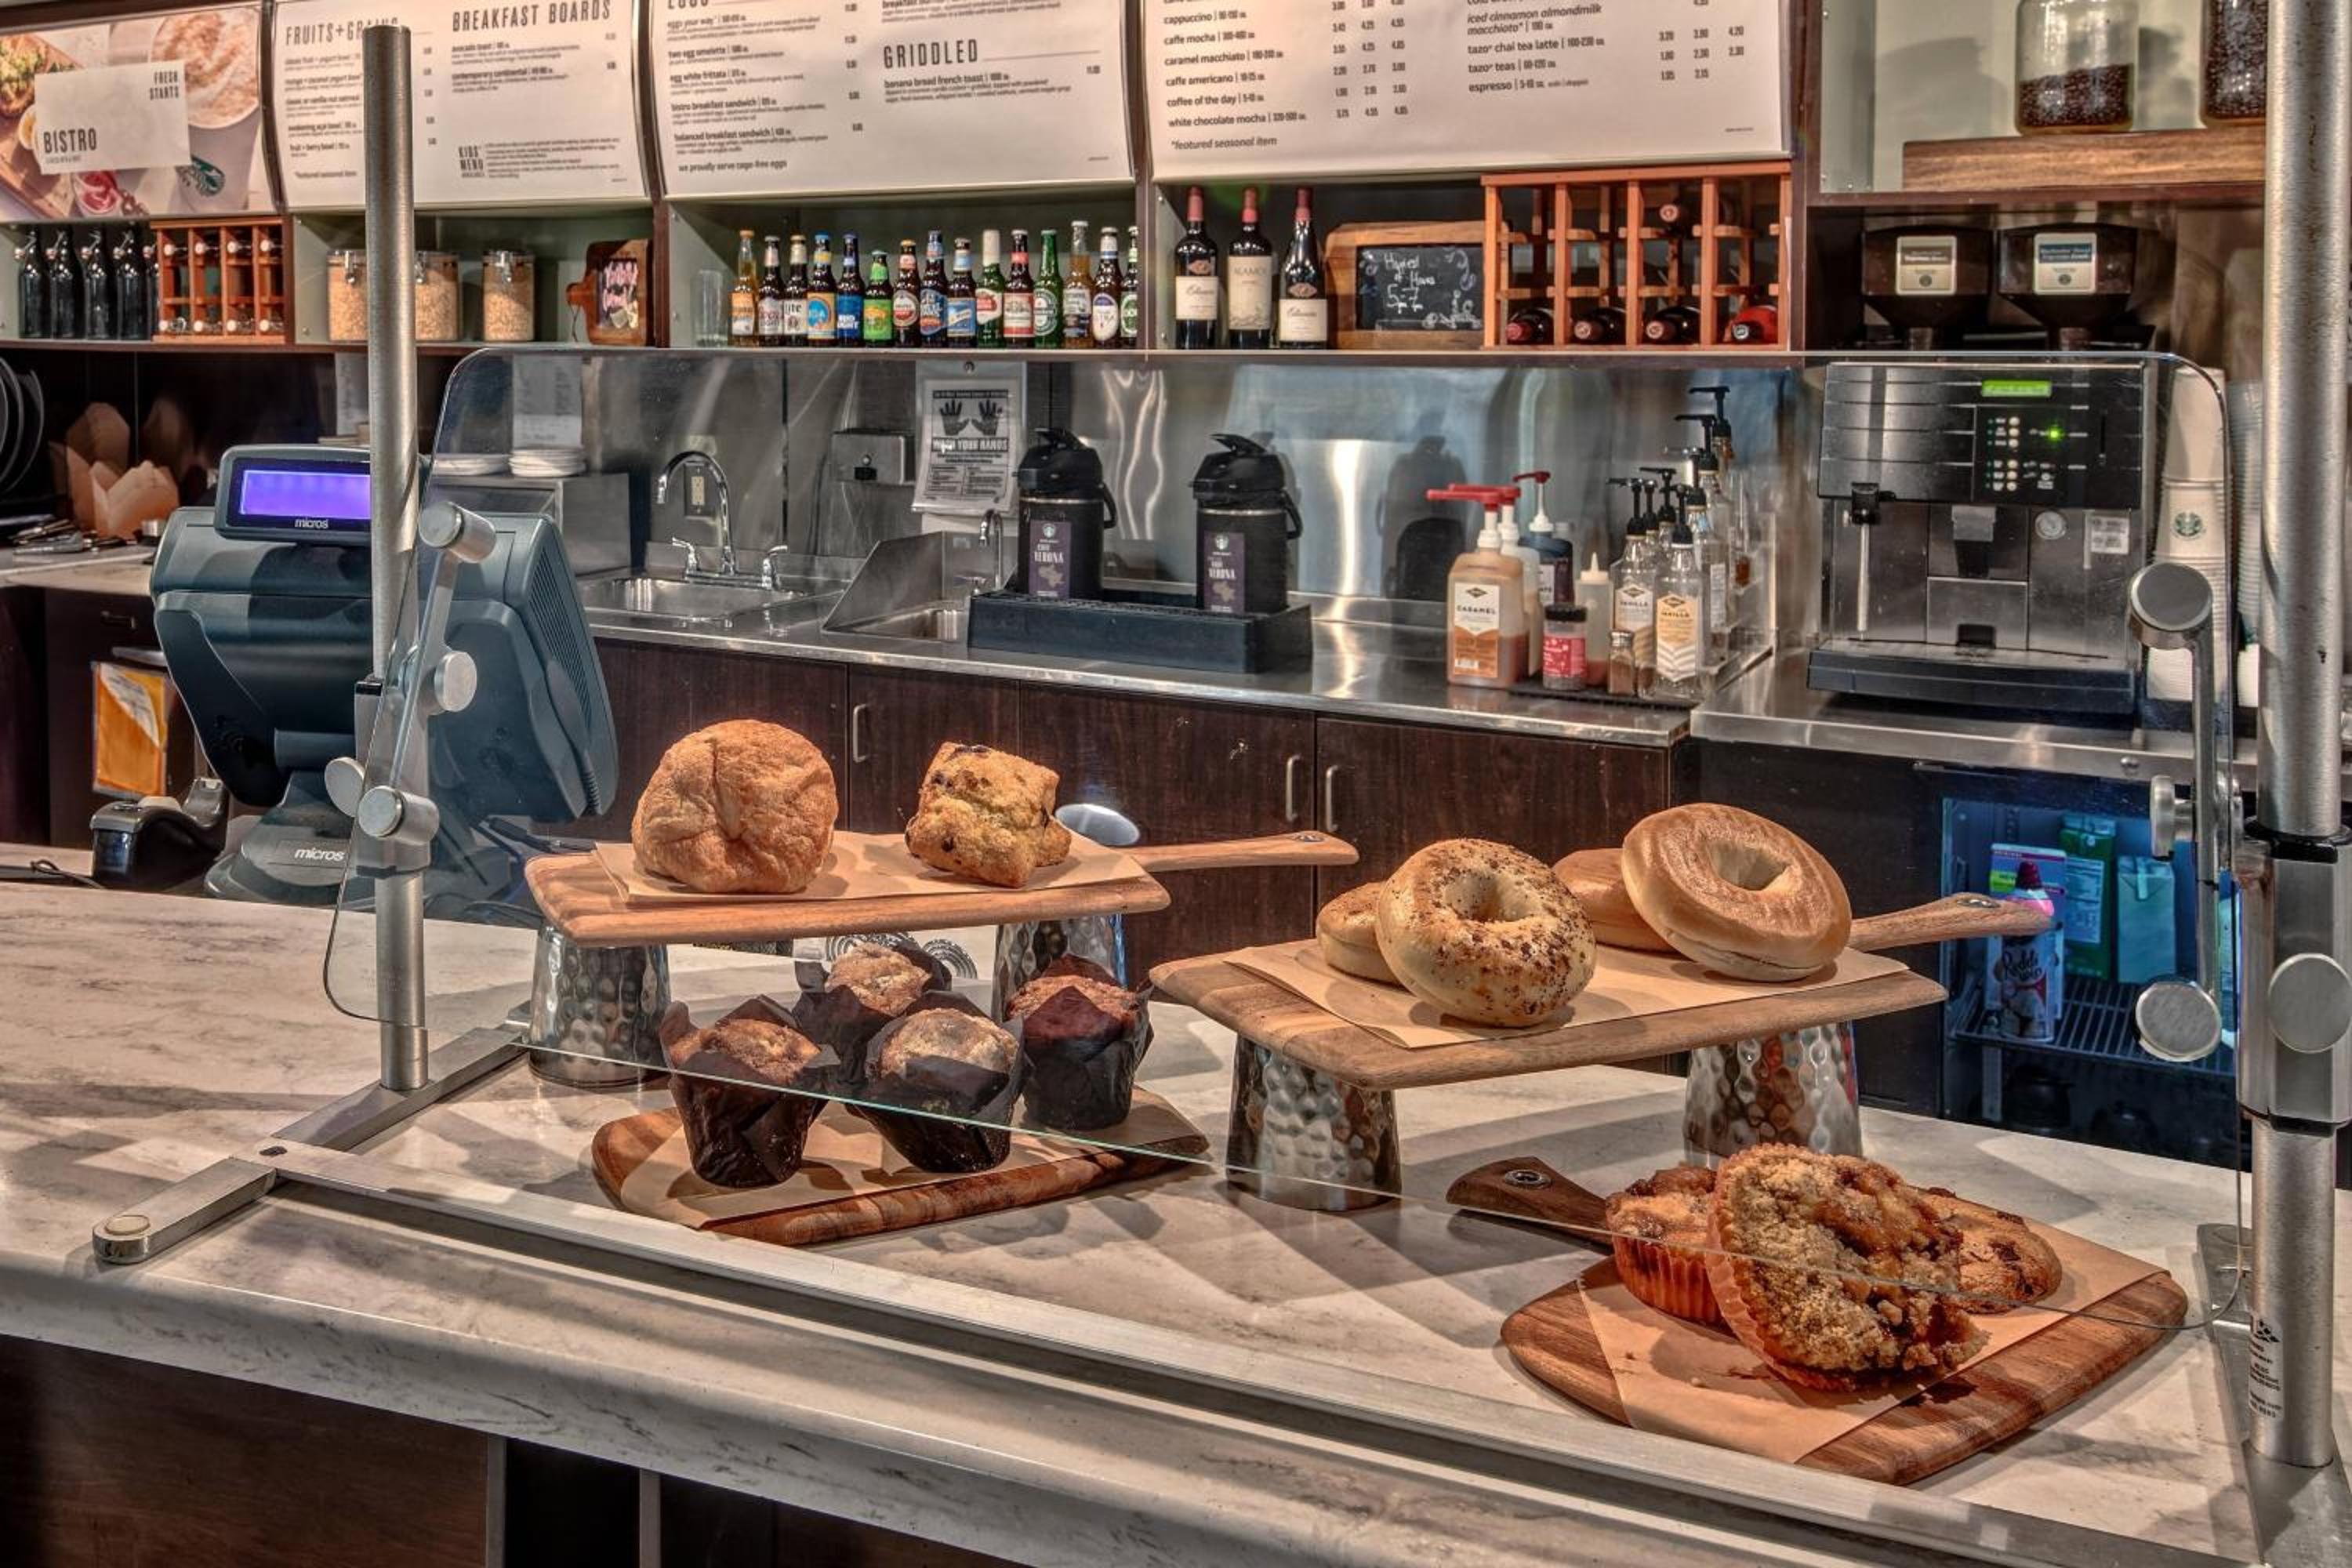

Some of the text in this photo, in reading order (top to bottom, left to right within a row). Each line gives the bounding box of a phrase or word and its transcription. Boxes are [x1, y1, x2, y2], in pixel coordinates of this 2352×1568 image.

[452, 0, 611, 32] BREAKFAST BOARDS
[1163, 13, 1213, 25] cappuccino
[1468, 3, 1602, 24] iced cinnamon almondmilk
[1186, 32, 1216, 43] mocha
[884, 38, 978, 69] GRIDDLED
[1494, 42, 1515, 53] chai
[1517, 41, 1533, 51] tea
[1164, 54, 1200, 66] caramel
[1200, 51, 1246, 64] macchiato
[1495, 62, 1515, 71] teas
[1188, 74, 1234, 85] americano
[1468, 81, 1512, 93] espresso
[1167, 96, 1192, 107] coffee
[1194, 95, 1203, 106] of
[1204, 94, 1219, 105] the
[1220, 93, 1236, 106] day
[1168, 117, 1192, 128] white
[1193, 114, 1235, 126] chocolate
[1236, 112, 1266, 123] mocha
[43, 128, 97, 153] BISTRO
[1214, 136, 1255, 148] seasonal
[294, 517, 328, 530] micros
[294, 847, 345, 862] micros
